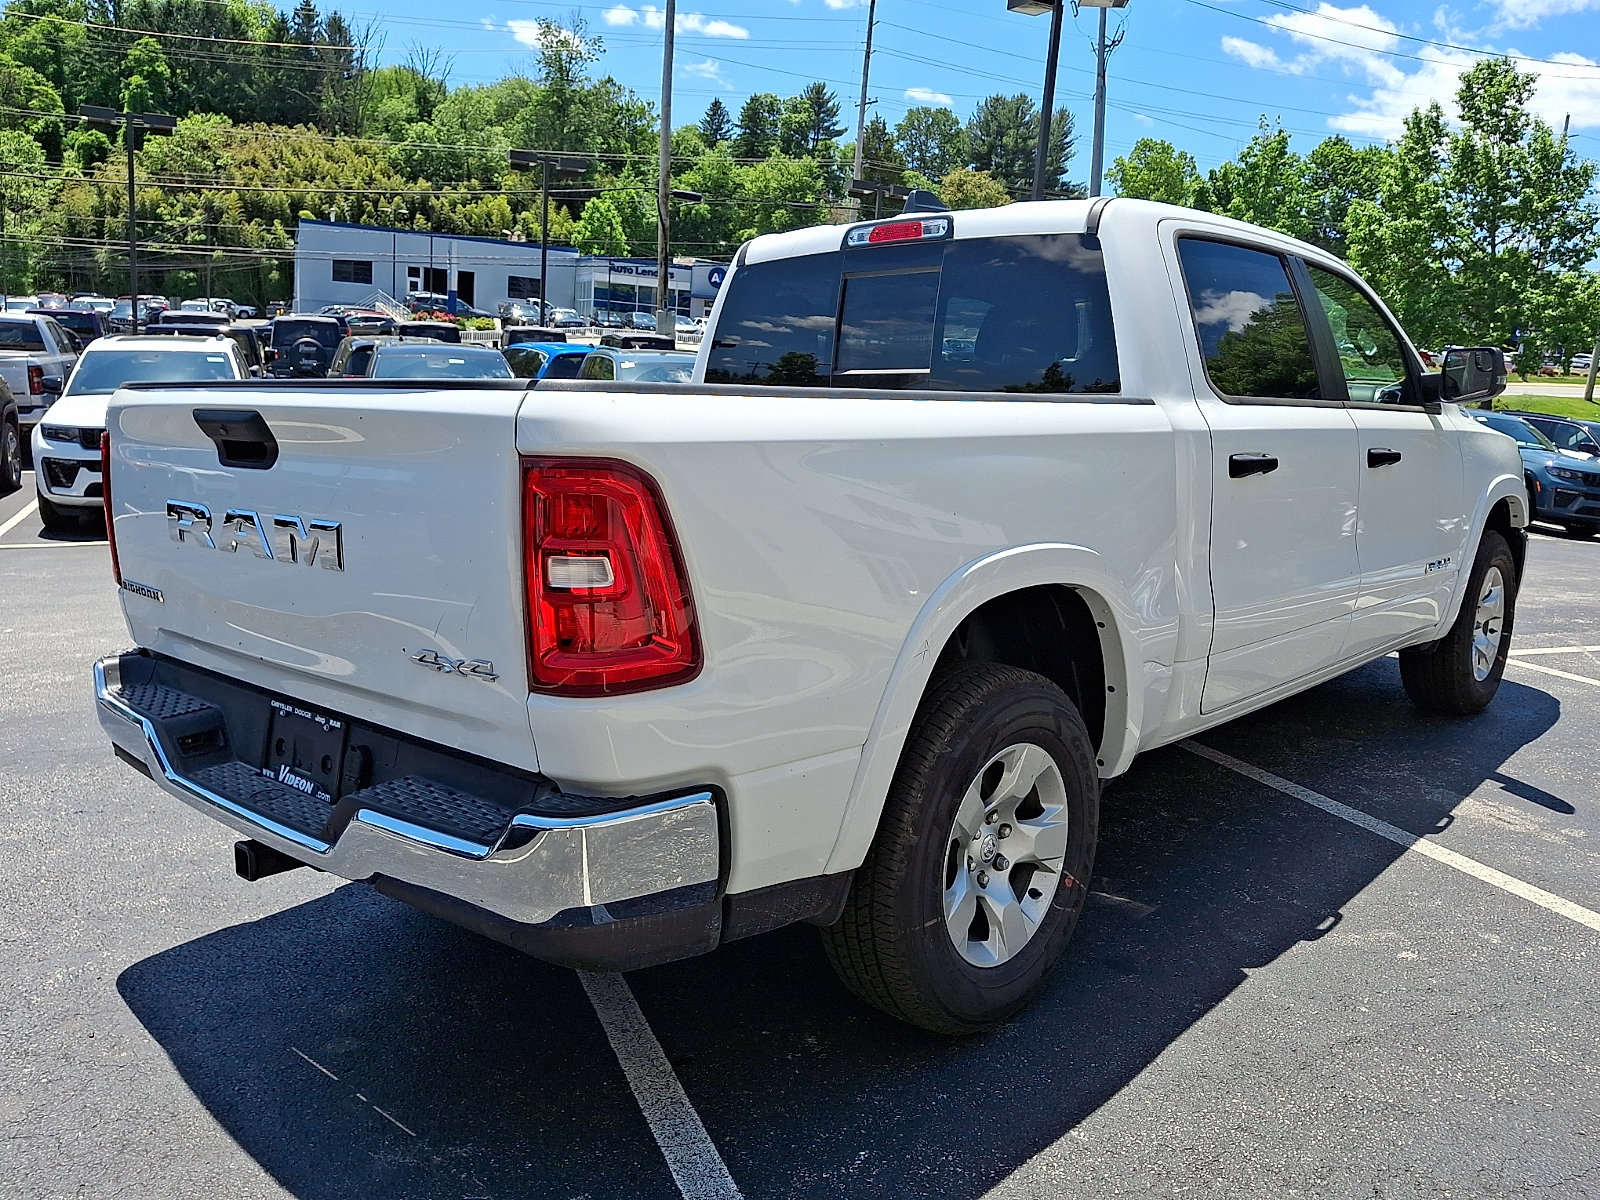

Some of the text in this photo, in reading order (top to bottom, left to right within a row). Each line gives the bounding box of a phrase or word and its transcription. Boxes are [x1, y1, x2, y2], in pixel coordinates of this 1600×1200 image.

[609, 263, 634, 275] Auto
[166, 499, 345, 572] RAM
[271, 700, 293, 712] CHRYSLER
[294, 708, 312, 719] DODGE
[329, 719, 341, 728] RAM
